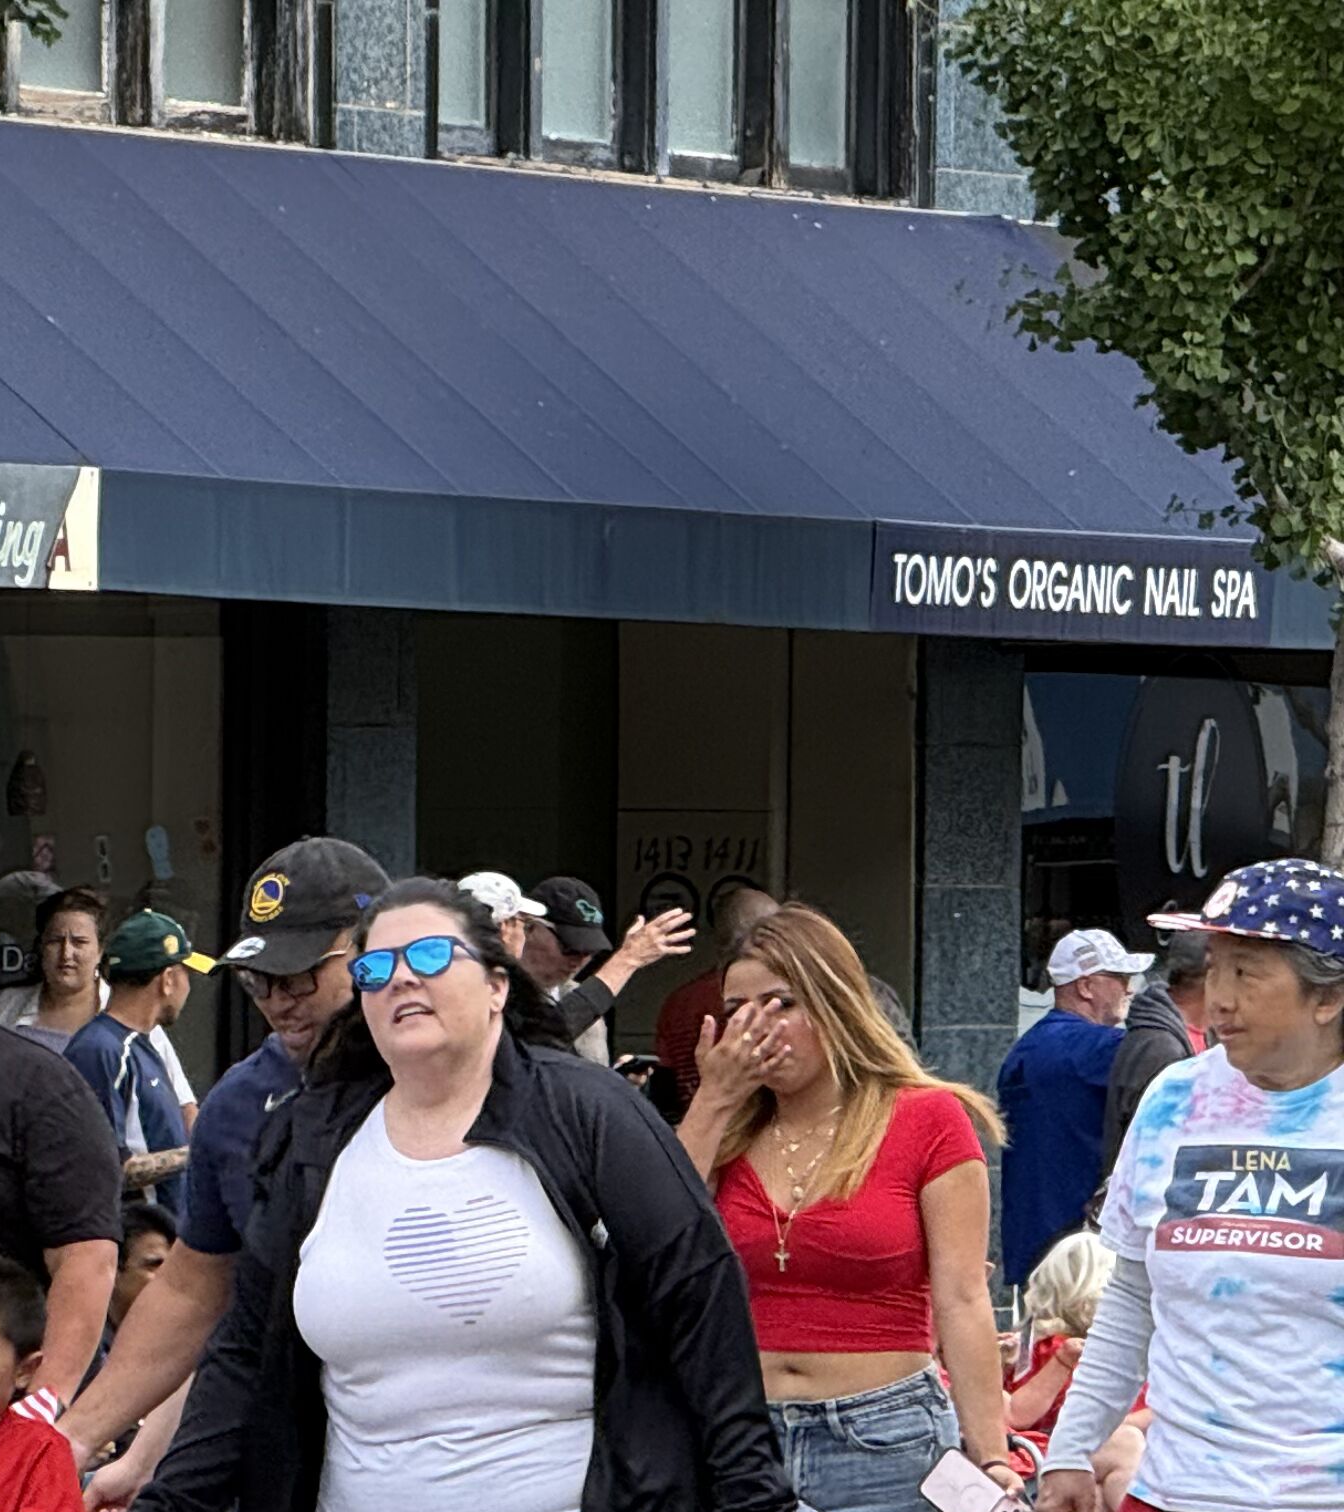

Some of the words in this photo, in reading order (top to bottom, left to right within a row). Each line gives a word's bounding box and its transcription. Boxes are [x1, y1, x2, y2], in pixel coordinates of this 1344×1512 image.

[893, 552, 998, 609] TOMO'S
[1009, 559, 1135, 616] ORGANIC
[1144, 566, 1201, 618] NAIL
[1211, 568, 1257, 619] SPA
[1231, 1149, 1292, 1172] LENA
[1194, 1171, 1328, 1216] TAM
[1171, 1226, 1324, 1252] SUPERVISOR
